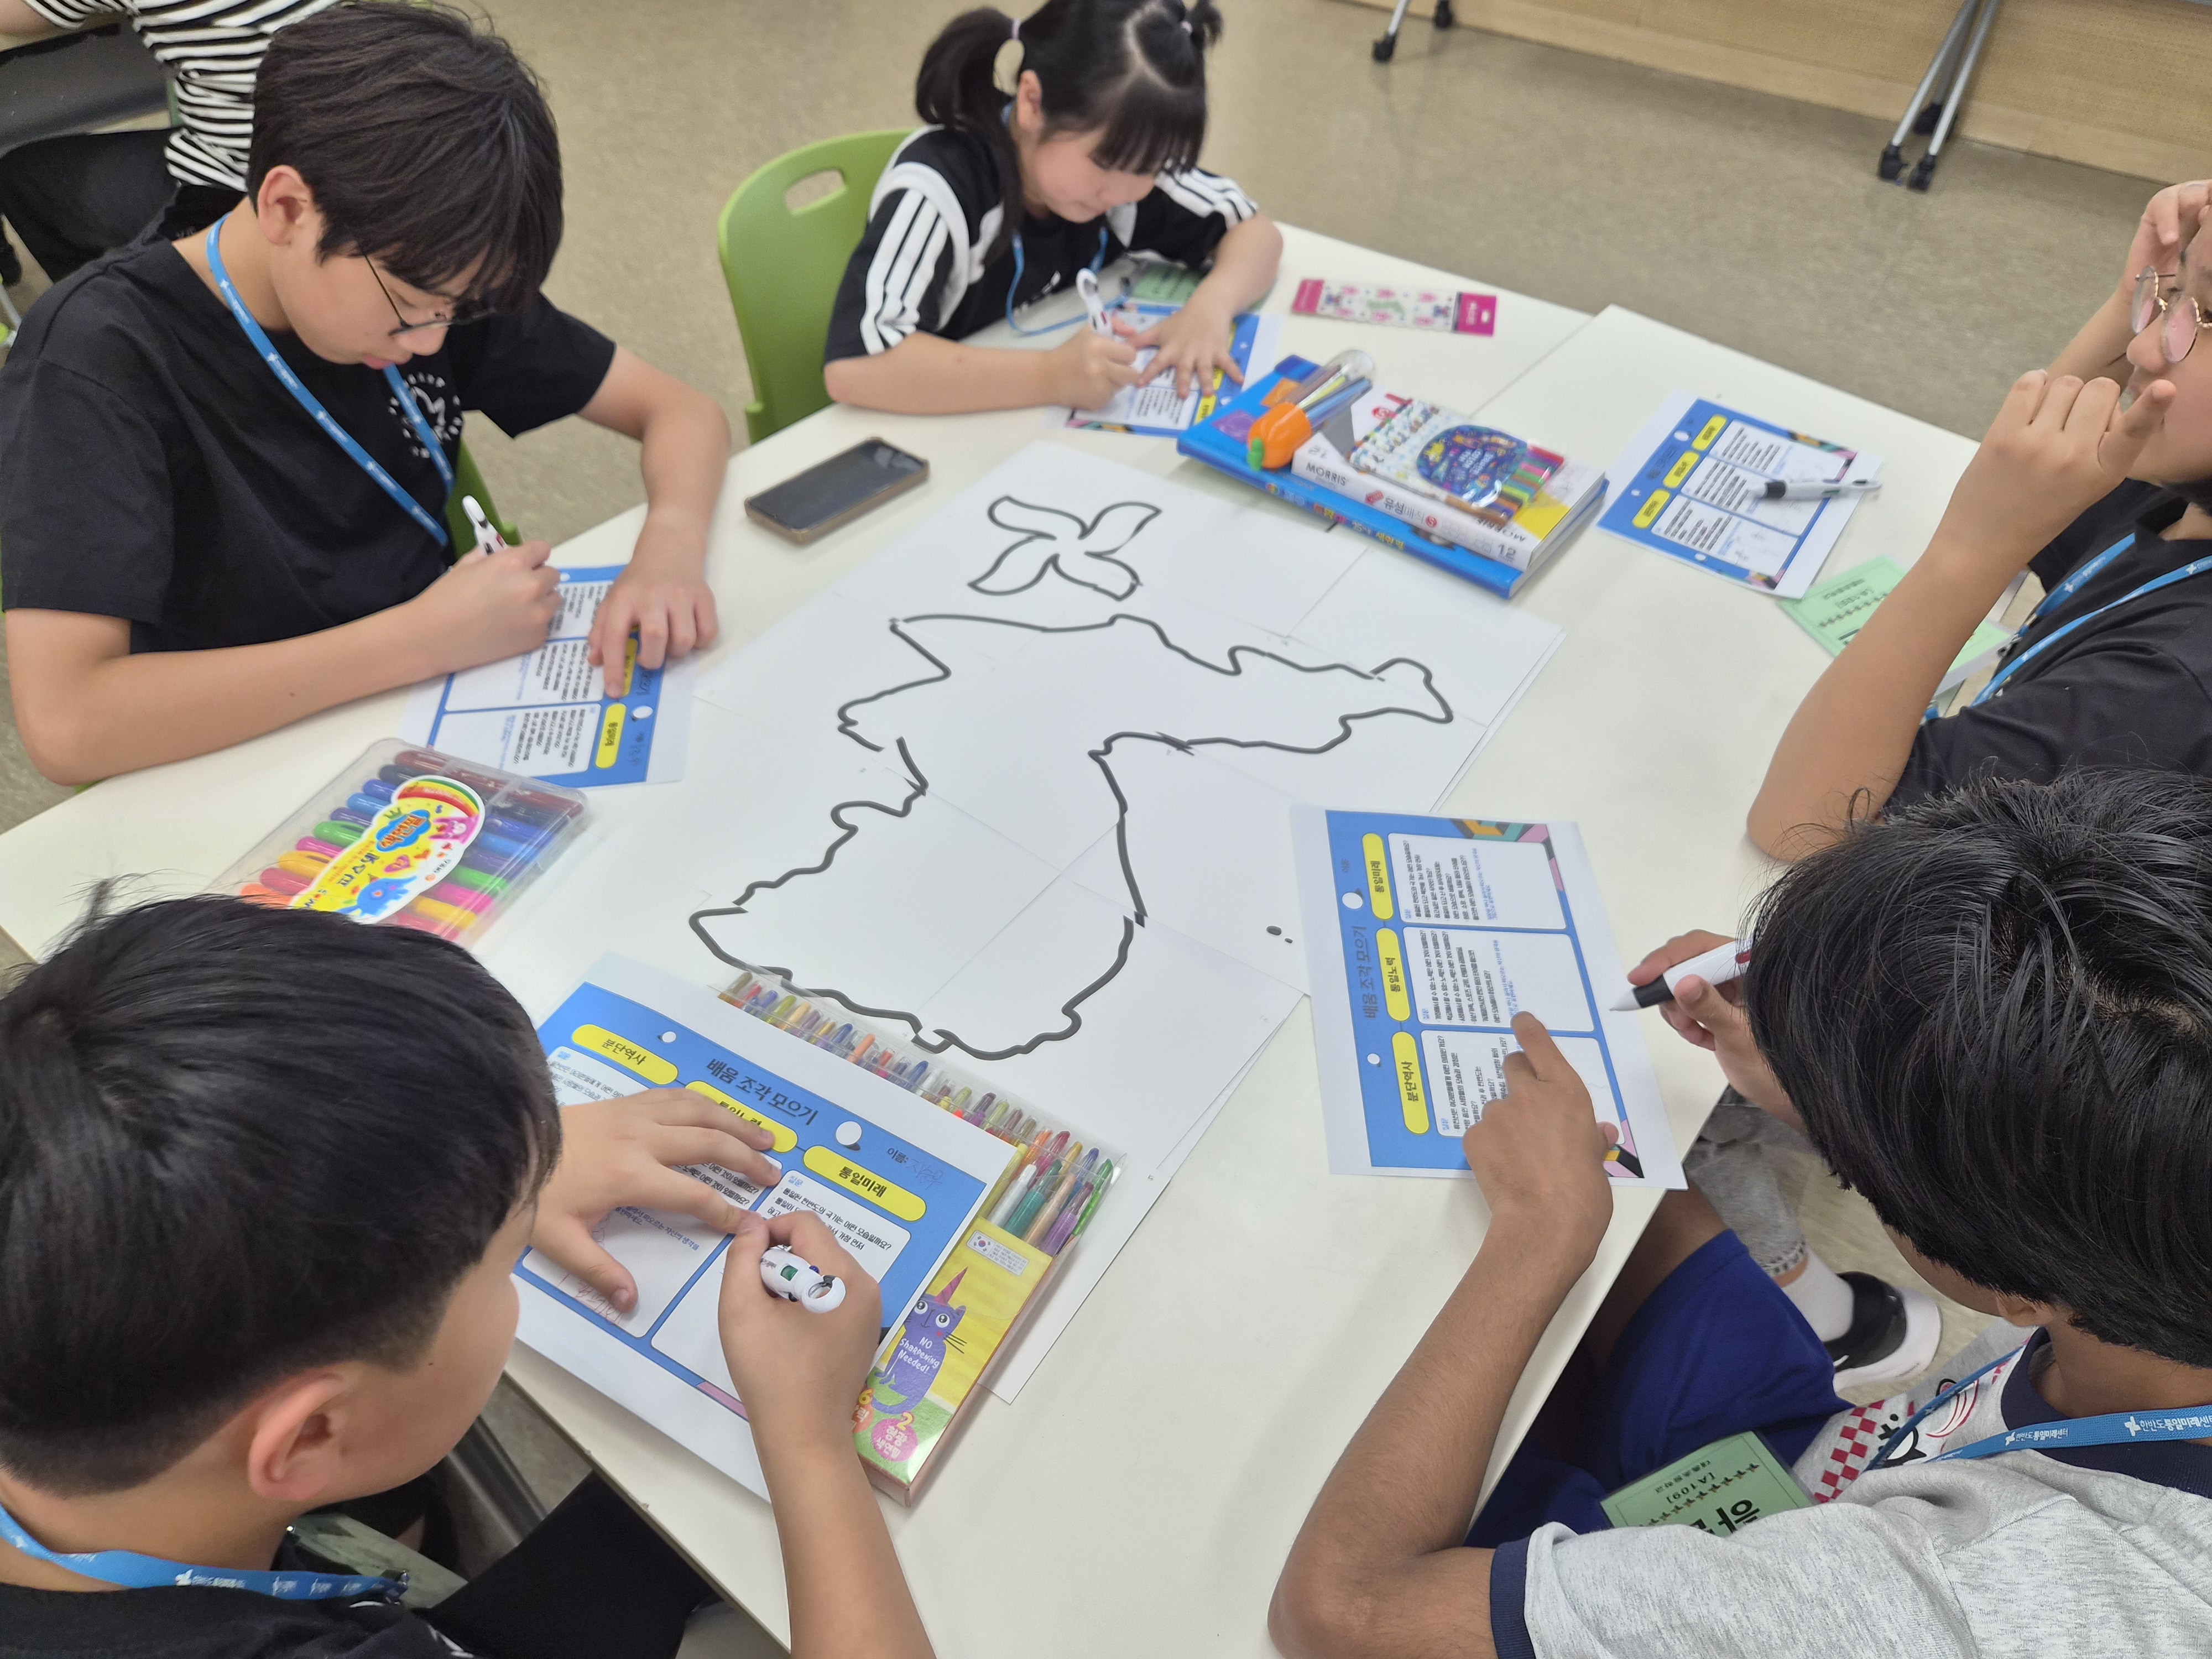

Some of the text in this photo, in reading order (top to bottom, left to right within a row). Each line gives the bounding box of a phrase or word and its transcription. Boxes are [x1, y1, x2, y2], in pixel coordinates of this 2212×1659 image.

[1306, 462, 1347, 487] MORRIS
[1498, 544, 1516, 558] 12
[1370, 860, 1385, 893] 통일미래
[1351, 926, 1380, 1019] 배움 조각 모으기
[1385, 957, 1401, 992] 통일노력
[601, 1036, 647, 1066] 분단역사
[703, 1057, 818, 1126] 배움 조각 모으기
[1400, 1061, 1418, 1102] 분단역사
[884, 1146, 910, 1165] 이름:
[698, 1173, 713, 1185] 어떤
[710, 1180, 724, 1192] 것이
[721, 1187, 750, 1207] 있을까요?
[708, 1162, 759, 1196] 어떤 것이 있을까요?
[787, 1175, 804, 1187] 질문
[837, 1165, 888, 1198] 통일미래
[774, 1197, 795, 1211] 통일이
[837, 1231, 852, 1243] 가장
[849, 1238, 865, 1250] 먼저
[781, 1187, 893, 1251] 통일된 한반도의 국기는 어떤 모습일까요?
[920, 1337, 933, 1349] NO
[899, 1349, 930, 1374] Needed!
[858, 1389, 873, 1405] 6
[886, 1425, 908, 1447] 형광
[896, 1412, 913, 1431] 2
[877, 1437, 901, 1459] 색연필
[1666, 1472, 1716, 1504] [A109]
